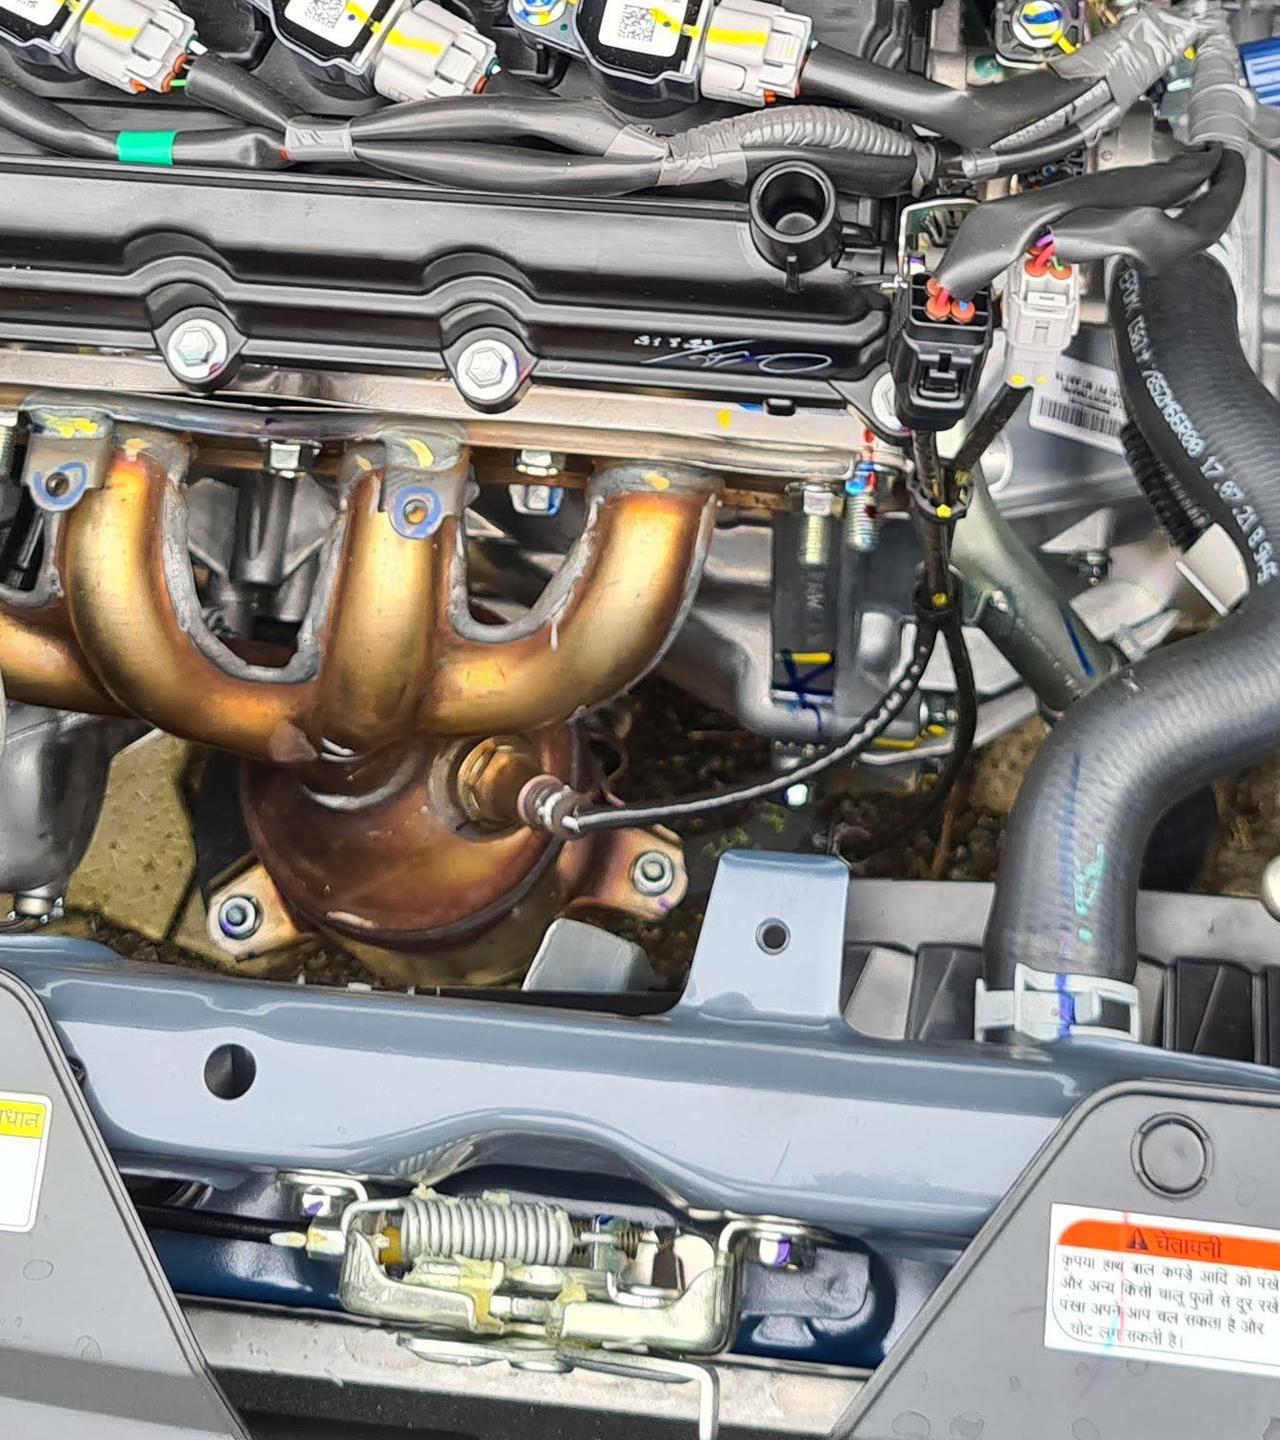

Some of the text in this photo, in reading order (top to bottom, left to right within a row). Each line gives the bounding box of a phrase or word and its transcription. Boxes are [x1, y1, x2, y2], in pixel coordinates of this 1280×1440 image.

[1156, 1231, 1222, 1258] चेतावनी
[1061, 1253, 1095, 1272] कृपया
[1103, 1258, 1124, 1273] हाथ
[1131, 1261, 1155, 1276] बाल
[1236, 1271, 1252, 1288] को
[1060, 1275, 1083, 1292] और
[1089, 1279, 1115, 1295] अन्य
[1121, 1280, 1152, 1300] किसी
[1218, 1292, 1231, 1308] से
[1236, 1295, 1253, 1315] दूर
[1091, 1299, 1121, 1317] अपने
[1127, 1305, 1150, 1321] आप
[1156, 1309, 1178, 1325] चल
[1184, 1312, 1222, 1330] सकता
[1227, 1312, 1236, 1333] है
[1240, 1317, 1264, 1335] और
[1127, 1326, 1162, 1346] सकती
